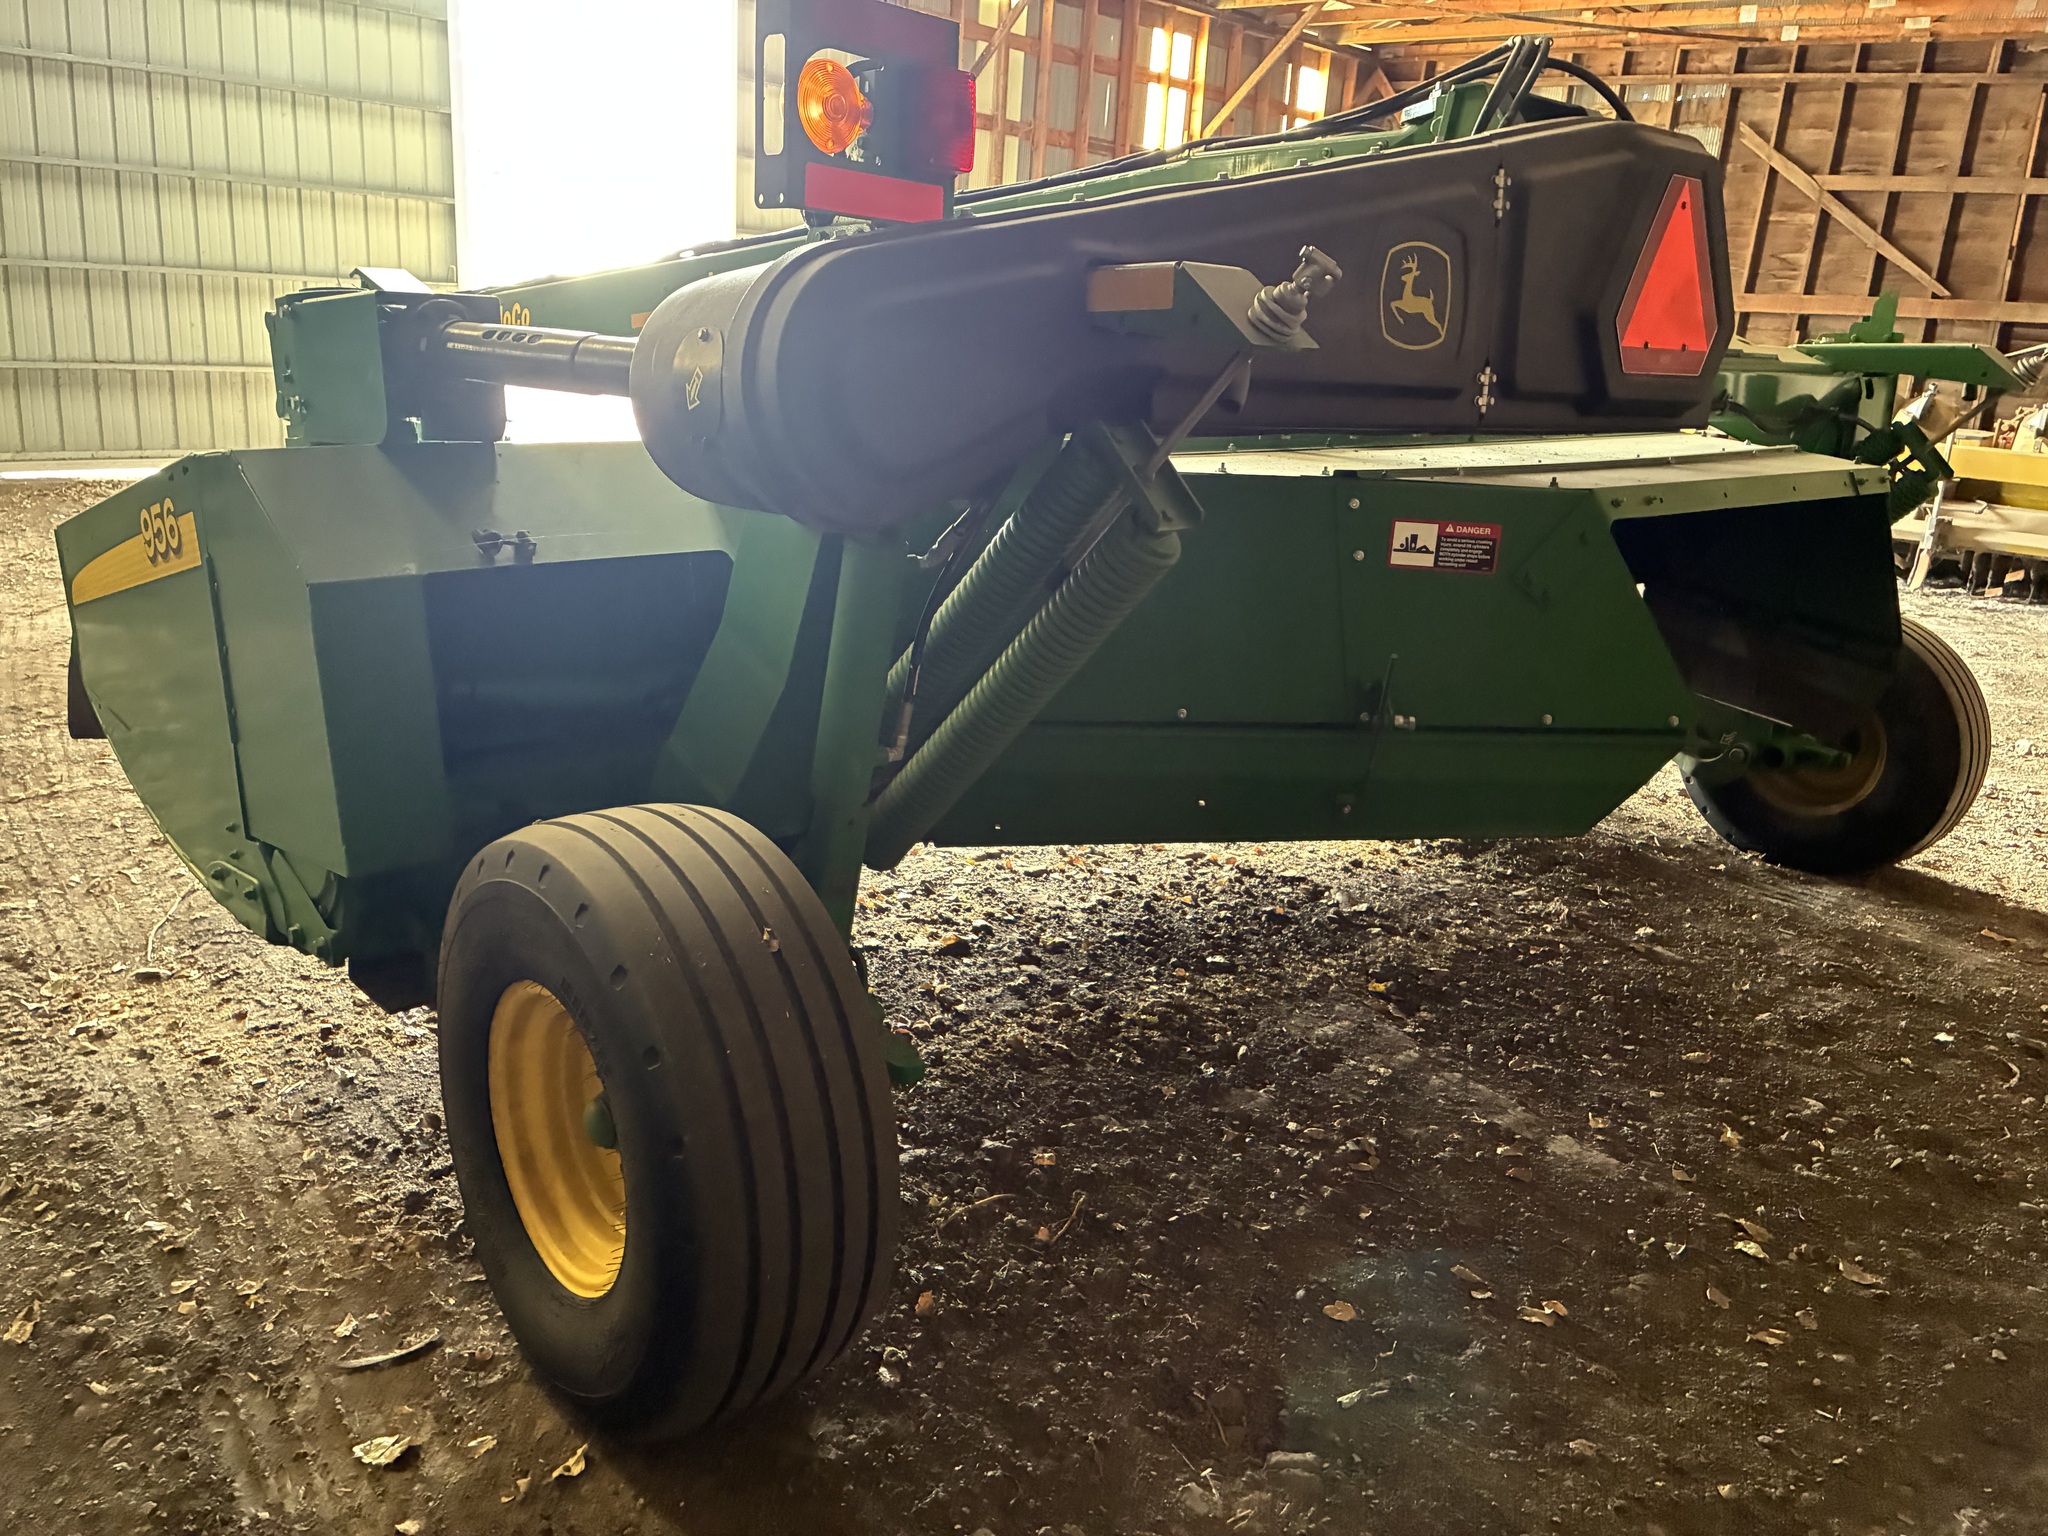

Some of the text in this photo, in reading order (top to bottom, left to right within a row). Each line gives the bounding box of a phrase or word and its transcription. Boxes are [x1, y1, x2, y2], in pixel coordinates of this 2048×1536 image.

[500, 302, 530, 326] oCo
[140, 497, 181, 562] 956
[1456, 525, 1491, 535] DANGER
